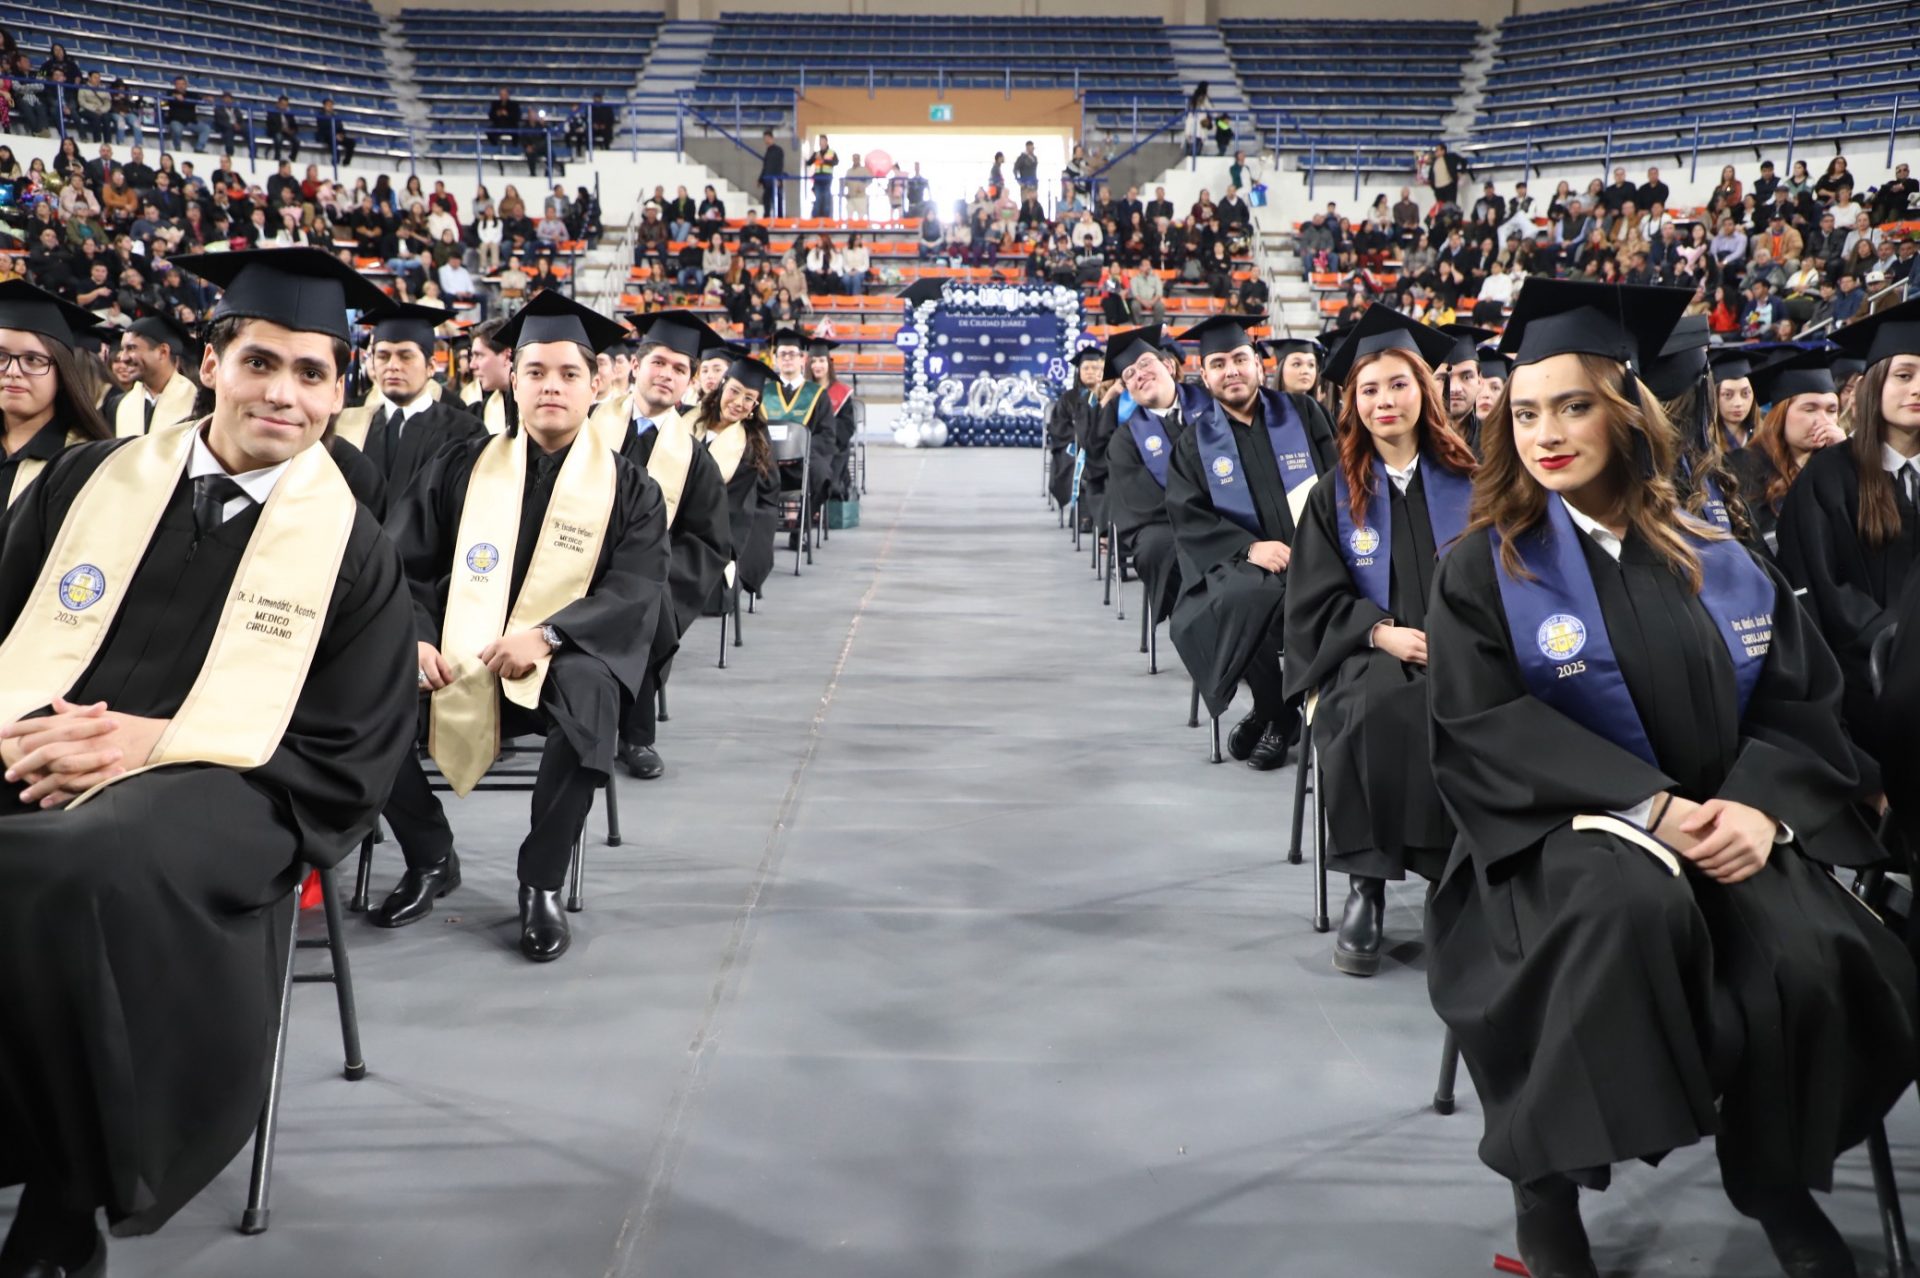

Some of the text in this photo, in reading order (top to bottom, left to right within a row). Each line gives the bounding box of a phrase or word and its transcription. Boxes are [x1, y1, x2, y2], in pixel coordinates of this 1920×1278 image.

[937, 377, 1049, 418] 2025
[237, 591, 246, 602] Dr.
[294, 604, 316, 620] Acosta
[54, 610, 79, 626] 2025
[254, 611, 290, 627] MEDICO
[245, 621, 292, 640] CIRUJANO
[1746, 643, 1769, 657] DENTIST
[1556, 660, 1586, 679] 2025
